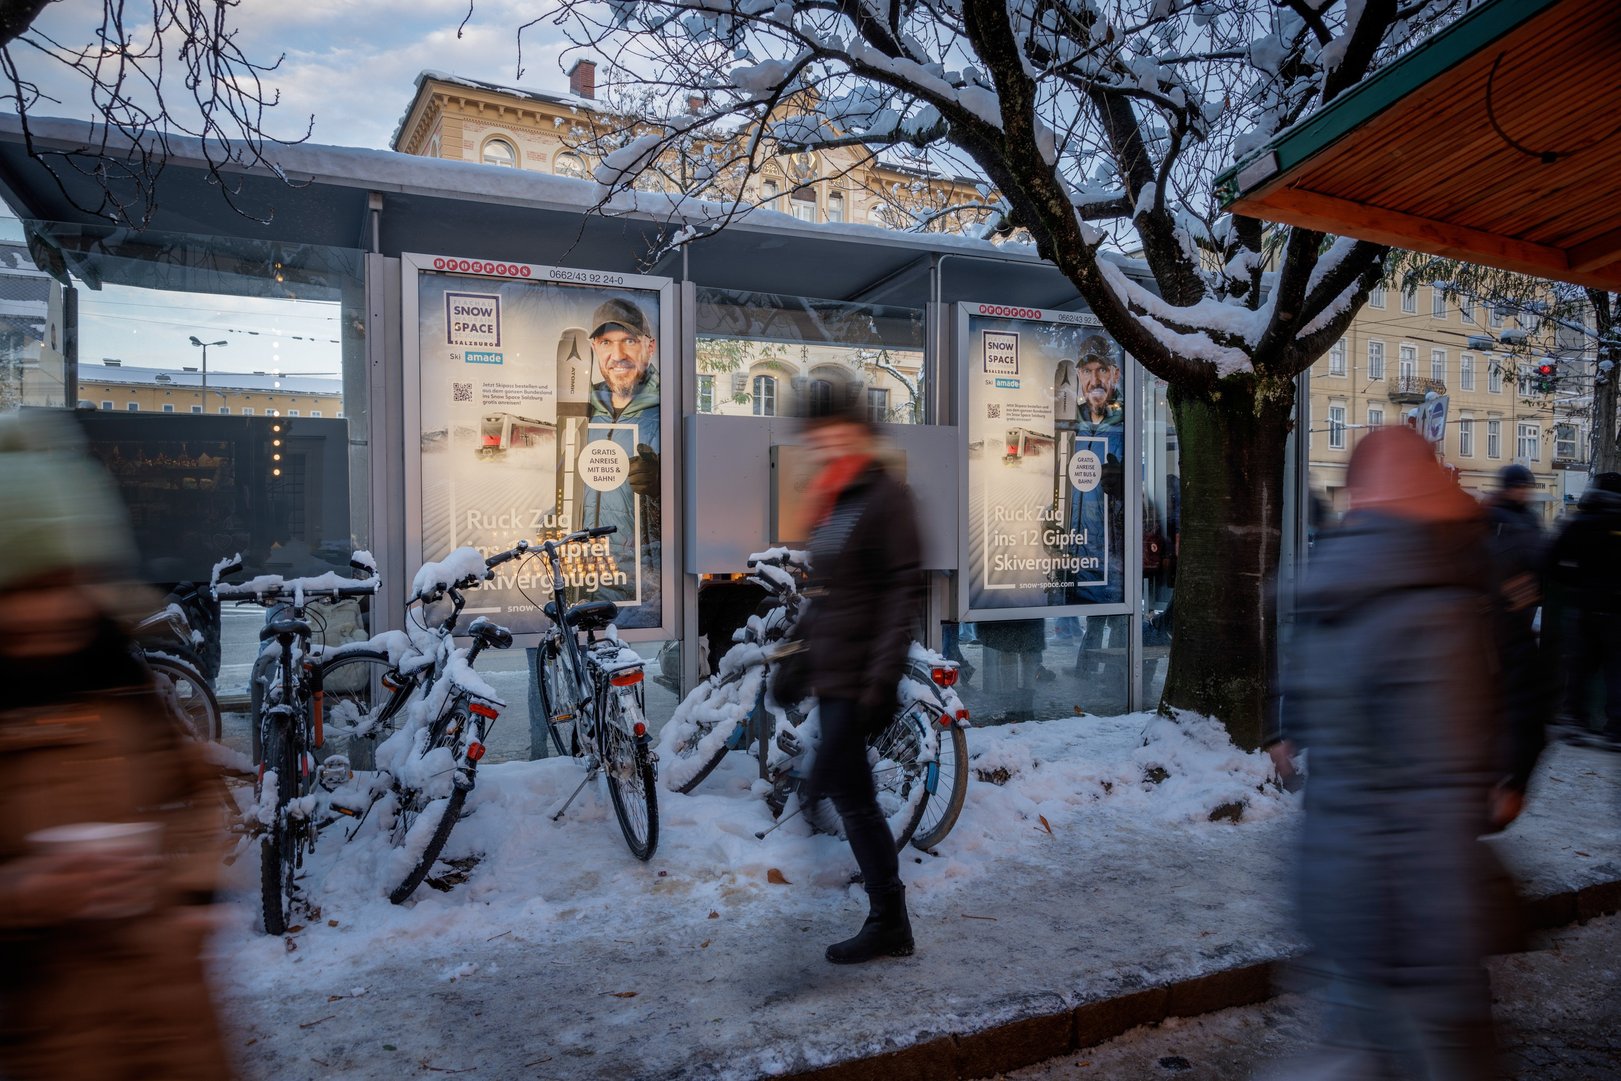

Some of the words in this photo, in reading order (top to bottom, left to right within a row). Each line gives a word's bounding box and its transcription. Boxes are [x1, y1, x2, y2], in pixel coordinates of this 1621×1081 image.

[434, 258, 531, 277] progress
[549, 269, 587, 282] 0662/43
[589, 273, 601, 283] 92
[603, 275, 624, 285] 24-0
[454, 305, 493, 317] SNOW
[979, 304, 1042, 319] progress
[1058, 313, 1083, 323] 0662/43
[1084, 316, 1092, 324] 92
[454, 322, 494, 334] SPACE
[987, 341, 1014, 351] SNOW
[988, 355, 1014, 364] SPACE
[467, 509, 523, 529] Ruck
[528, 509, 572, 535] Zug
[994, 505, 1033, 521] Ruck
[1036, 505, 1065, 526] Zug
[994, 530, 1016, 546] ins
[1020, 530, 1039, 546] 12
[1043, 529, 1088, 550] Gipfel
[994, 553, 1099, 575] Skivergnügen
[1019, 581, 1075, 589] snow-space.com
